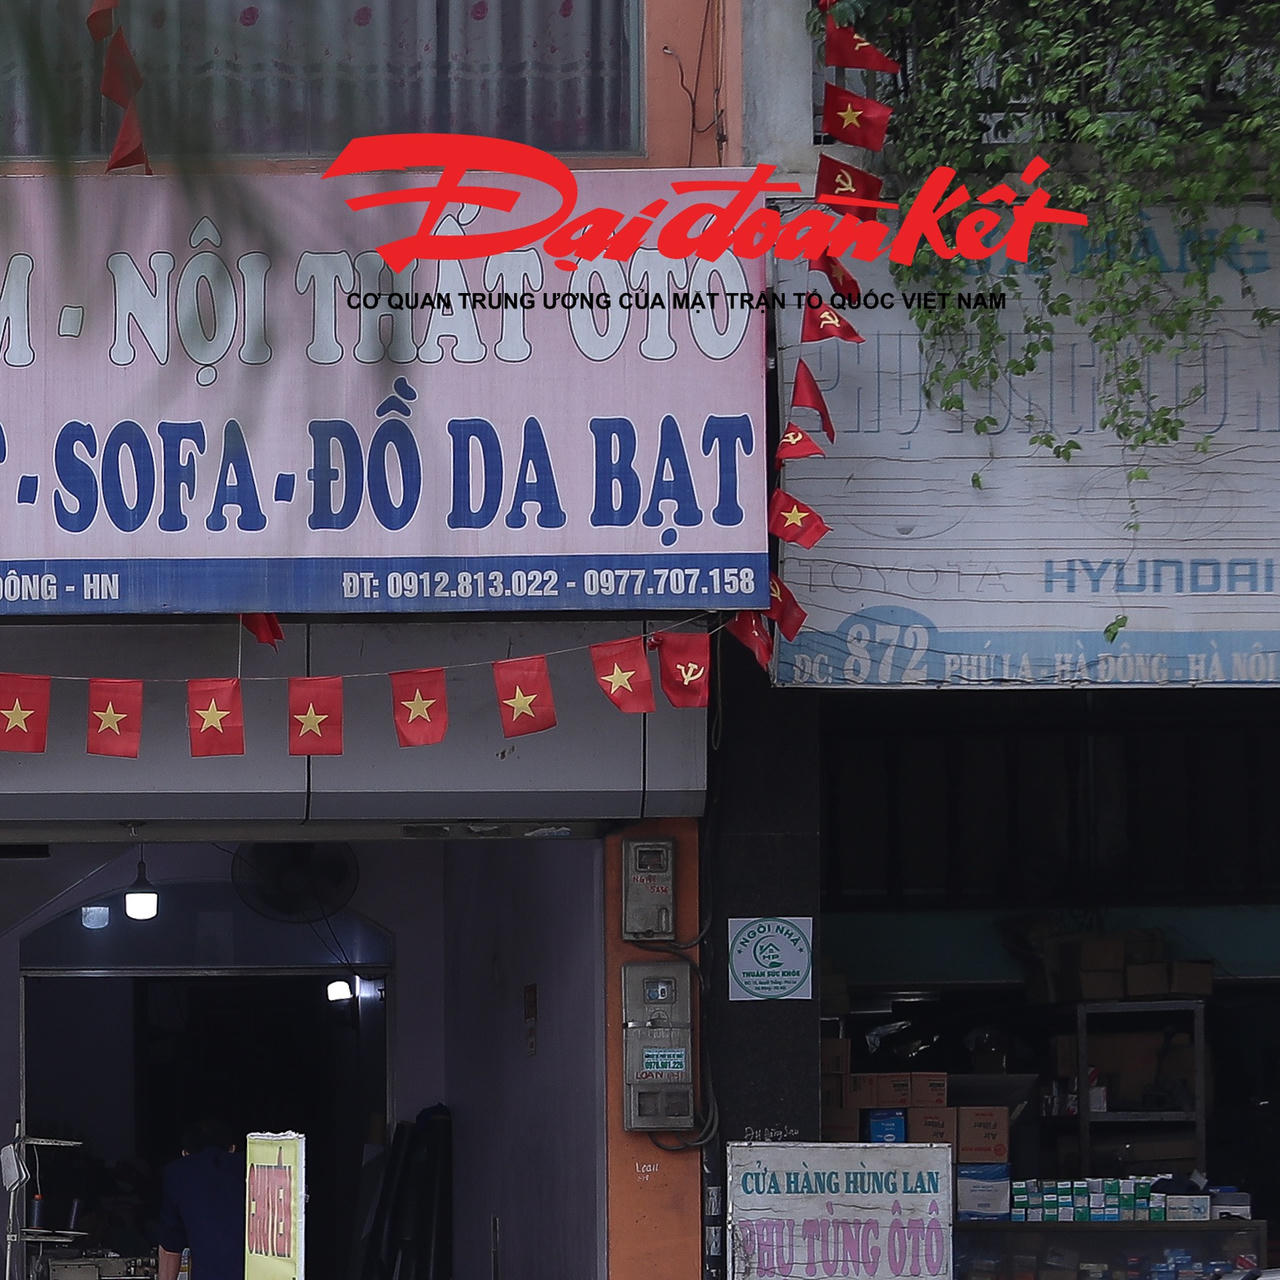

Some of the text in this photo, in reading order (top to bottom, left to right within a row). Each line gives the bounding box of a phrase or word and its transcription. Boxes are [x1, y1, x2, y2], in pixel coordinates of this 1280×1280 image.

[107, 216, 272, 386] NỘI
[295, 203, 533, 365] THẤT
[53, 418, 268, 534] SOFA
[306, 375, 422, 533] ĐỒ
[446, 416, 567, 531] DA
[588, 412, 756, 547] BẠT
[83, 573, 119, 600] HN
[342, 572, 380, 598] ĐT:
[387, 569, 559, 598] 0912.813.022
[584, 567, 755, 595] 0977.707.158
[798, 558, 1275, 594] TOYOTA HYUNDAI
[793, 653, 833, 684] ĐC:
[843, 624, 929, 684] 872
[1097, 642, 1169, 685] ĐÔNG
[1188, 639, 1226, 683] HÀ
[739, 923, 771, 948] NGÔI
[741, 1160, 782, 1195] CỬA
[785, 1161, 840, 1195] HÀNG
[844, 1161, 898, 1195] HÙNG
[902, 1171, 941, 1195] LAN
[802, 1200, 881, 1278] TÙNG
[887, 1199, 944, 1278] ÔTÔ
